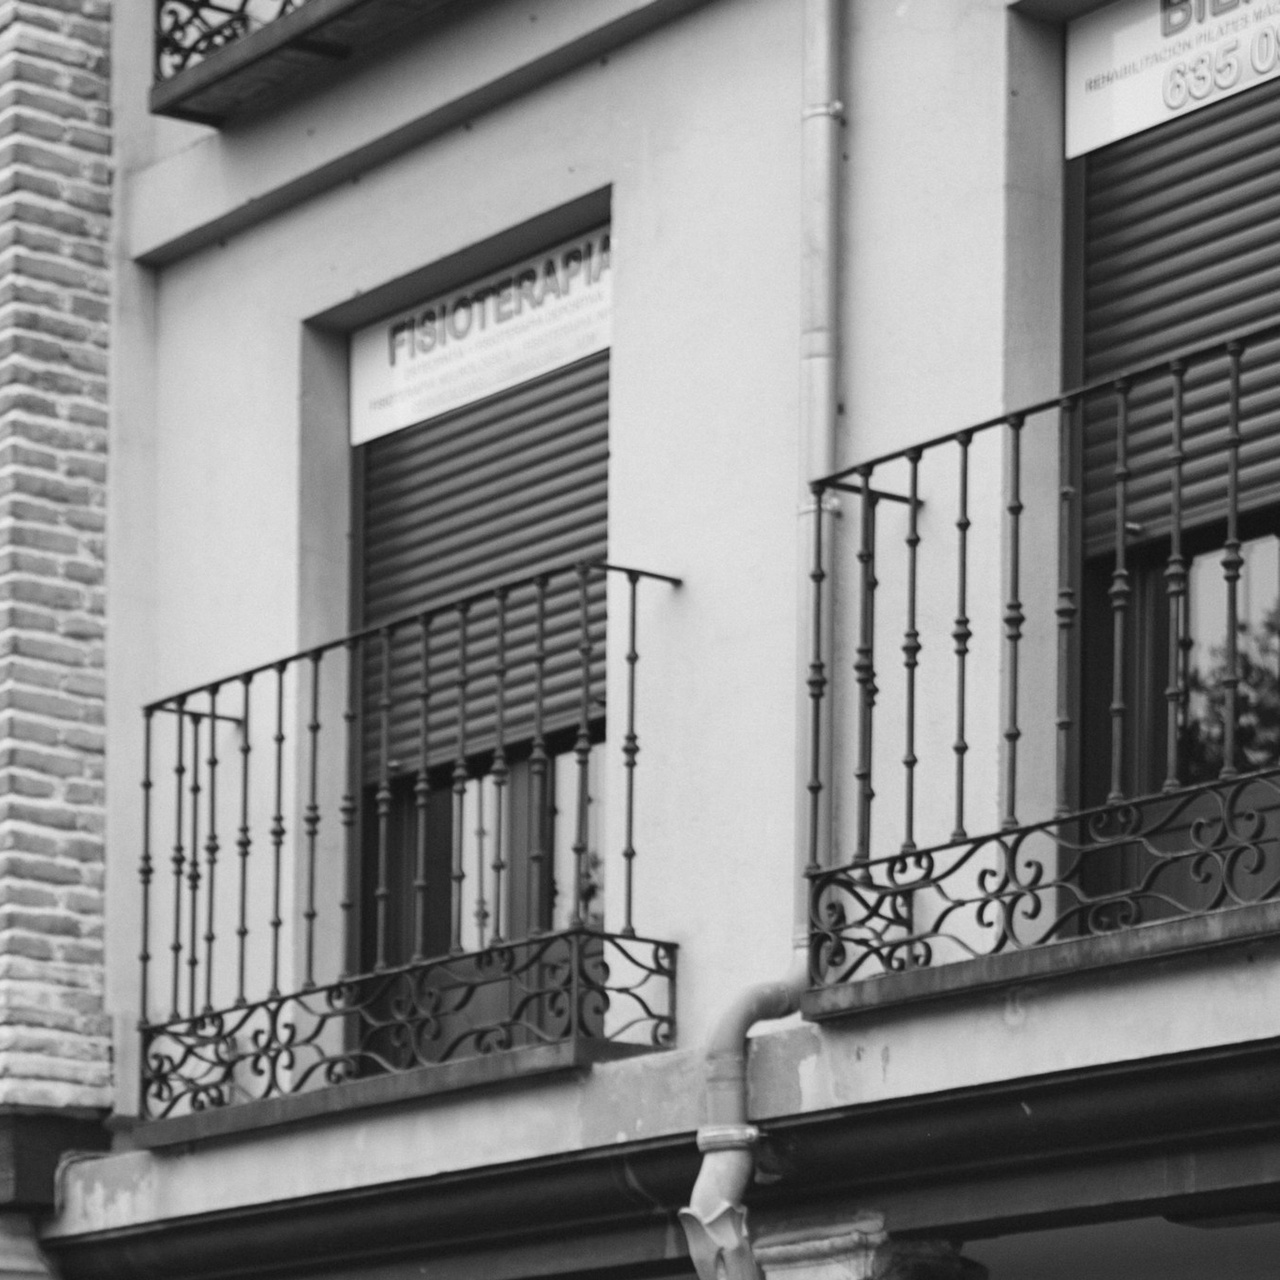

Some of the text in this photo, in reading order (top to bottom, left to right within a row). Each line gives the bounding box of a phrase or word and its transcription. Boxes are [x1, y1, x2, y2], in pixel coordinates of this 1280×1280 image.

[1162, 24, 1280, 110] 635 0
[1195, 14, 1249, 46] PILATES
[387, 233, 611, 366] FISIOTERAPIA
